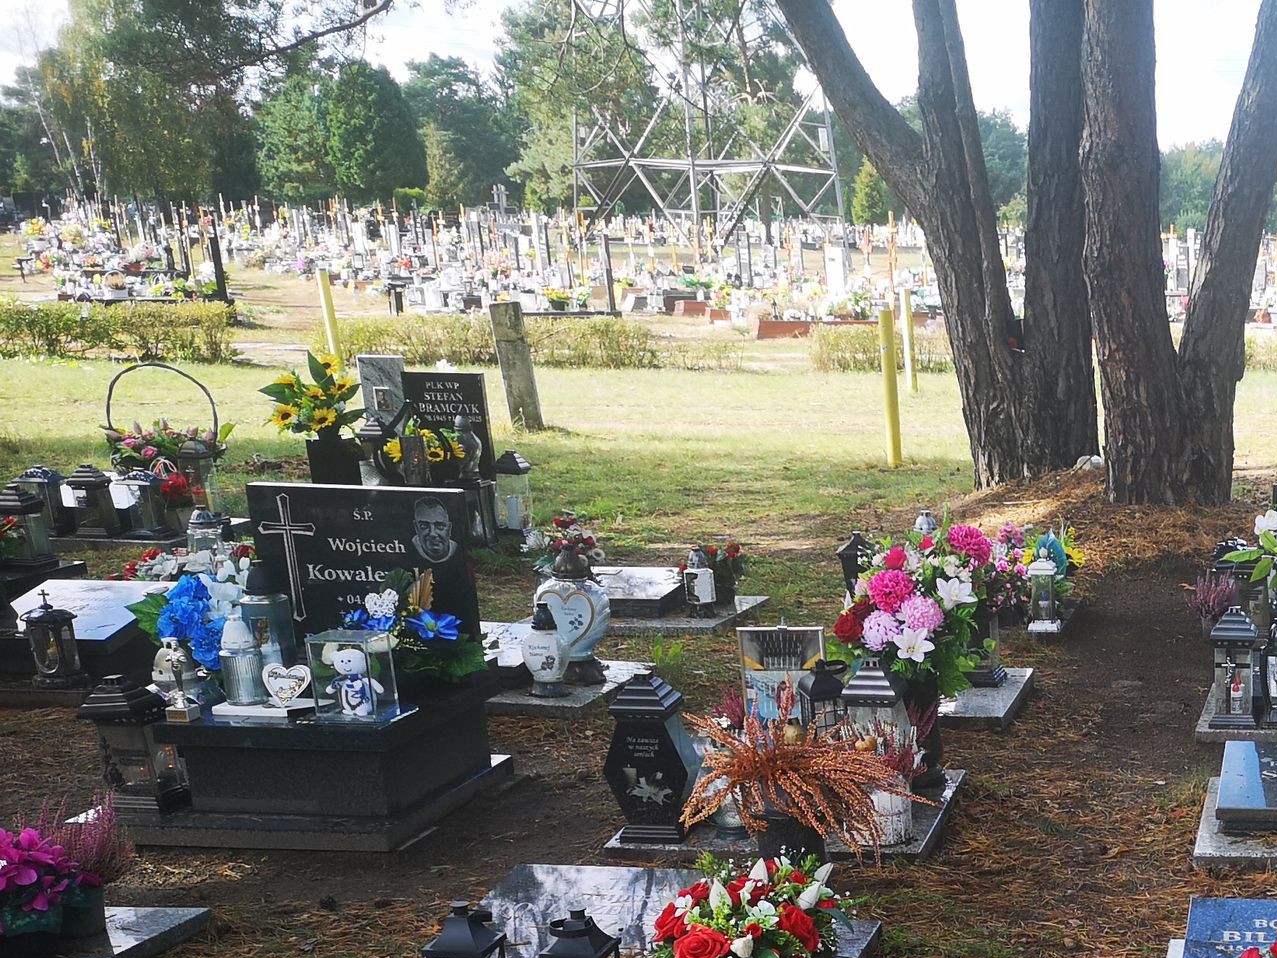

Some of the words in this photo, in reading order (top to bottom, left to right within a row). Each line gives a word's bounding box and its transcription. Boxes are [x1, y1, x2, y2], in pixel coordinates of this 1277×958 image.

[424, 391, 463, 401] STEFAN
[414, 402, 480, 414] BRAMCZYK
[327, 537, 406, 556] Wojciech
